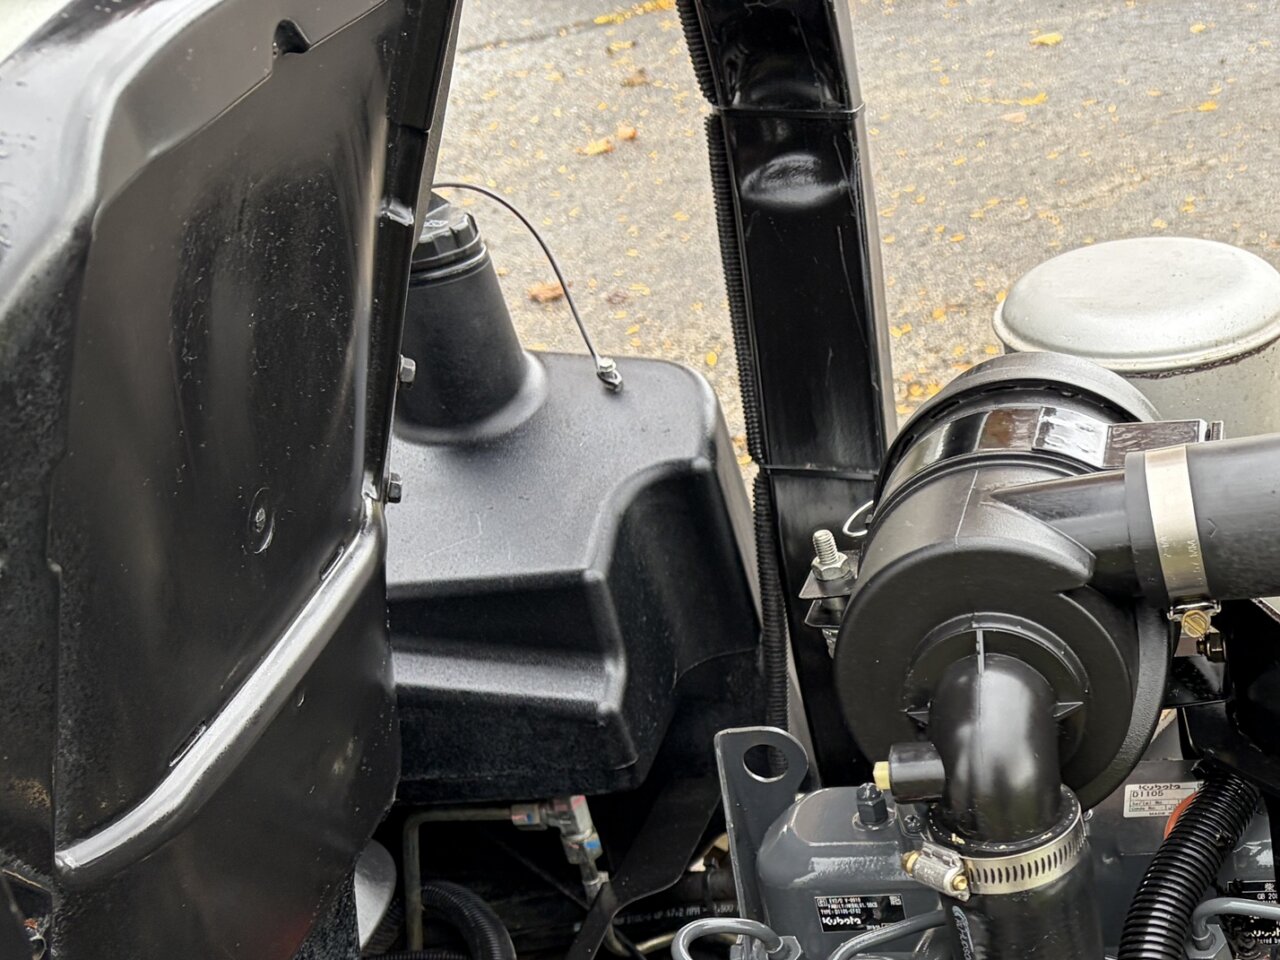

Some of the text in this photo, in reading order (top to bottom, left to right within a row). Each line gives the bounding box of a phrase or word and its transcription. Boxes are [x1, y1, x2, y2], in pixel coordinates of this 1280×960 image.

[1139, 783, 1181, 791] Kubota
[1132, 790, 1164, 798] D1105
[822, 916, 862, 926] Kubota
